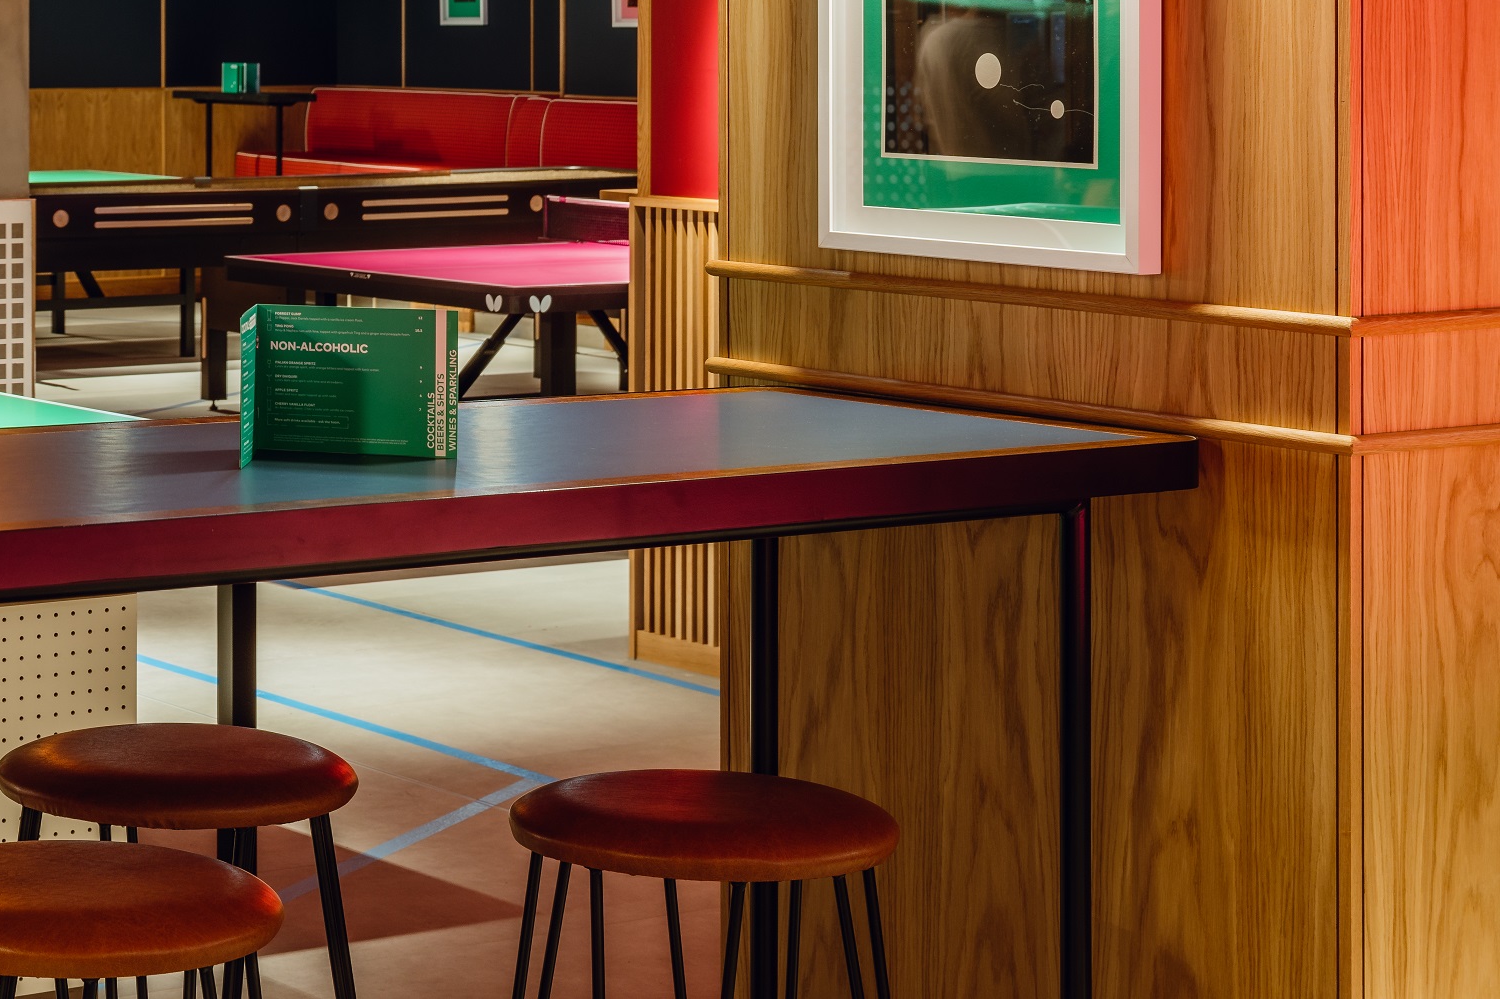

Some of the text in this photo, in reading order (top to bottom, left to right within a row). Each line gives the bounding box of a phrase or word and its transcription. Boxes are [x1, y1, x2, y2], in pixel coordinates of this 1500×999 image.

[270, 340, 369, 354] NON-ALCOHOLIC
[427, 392, 435, 449] COCKTAILS
[437, 373, 445, 451] BEERS & SHOTS
[449, 349, 458, 452] WINES & SPARKLING
